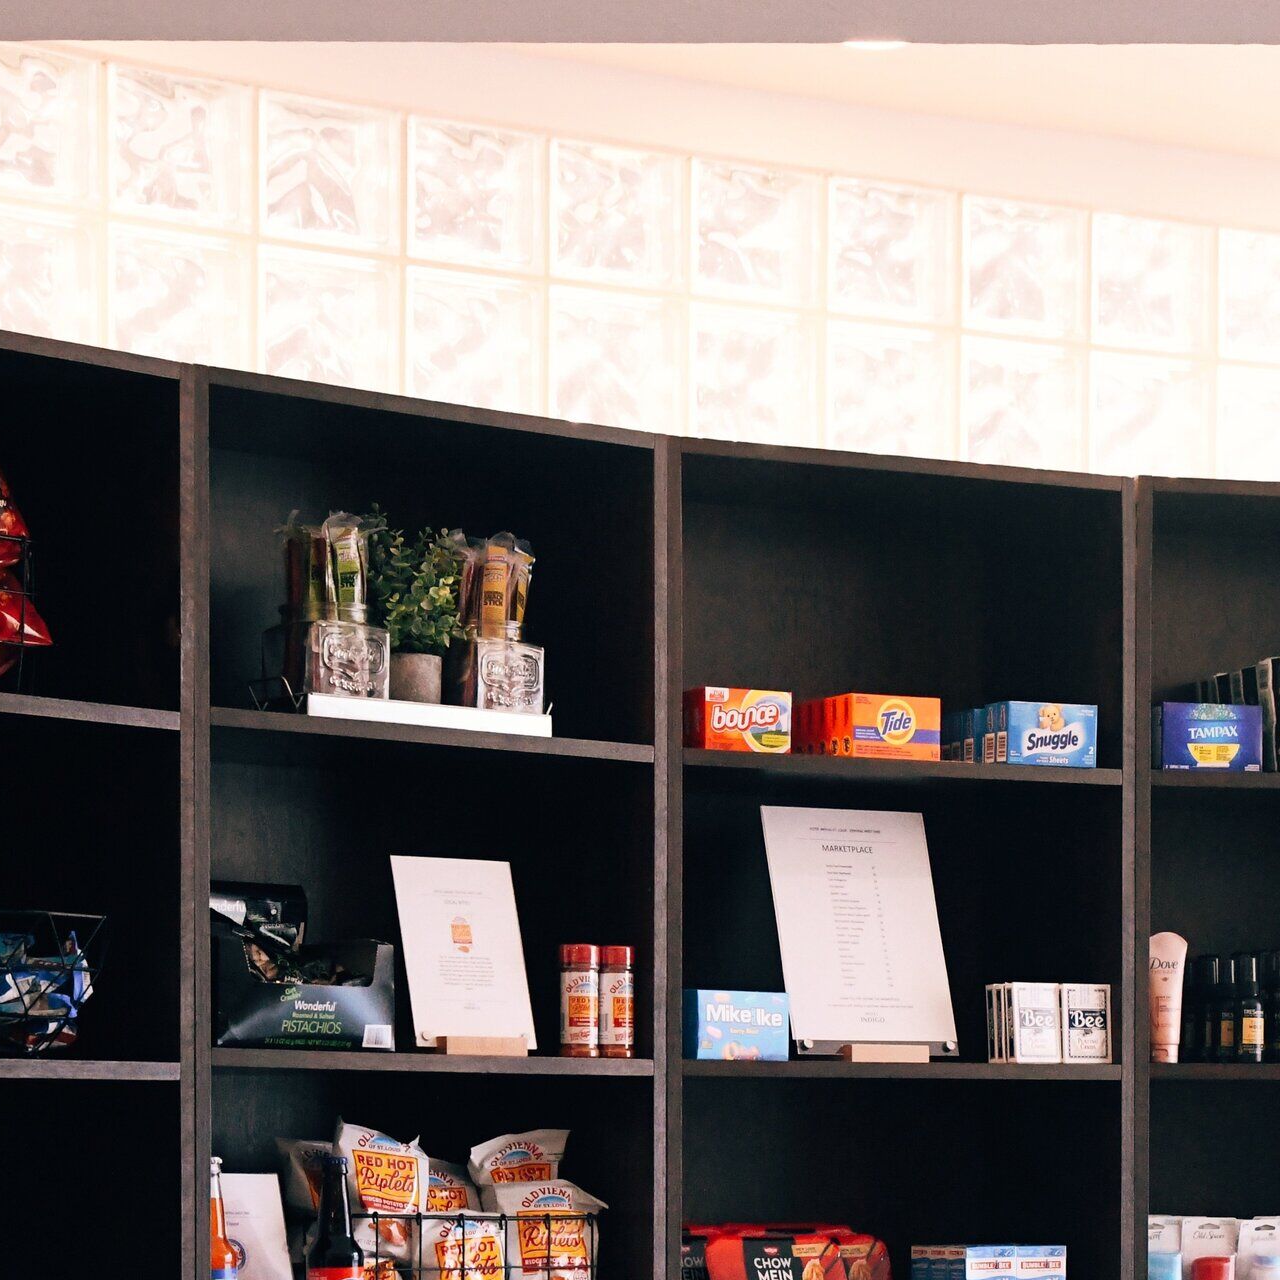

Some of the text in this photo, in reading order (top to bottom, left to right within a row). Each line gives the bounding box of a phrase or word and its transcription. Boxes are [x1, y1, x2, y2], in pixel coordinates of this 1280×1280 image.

[483, 599, 504, 607] STICK
[712, 703, 779, 731] bounce
[881, 711, 911, 735] Tide
[1188, 725, 1238, 739] TAMPAX
[1027, 729, 1079, 751] Snuggle
[1088, 746, 1095, 755] 2
[1049, 755, 1069, 765] Sheets
[822, 845, 873, 854] MARKETPLACE
[1150, 957, 1178, 970] Dove
[565, 979, 579, 994] OLD
[609, 979, 623, 994] OLD
[294, 1001, 336, 1011] Wonderful
[706, 1004, 783, 1026] Mike Ike
[860, 1016, 885, 1024] INDIGO
[1021, 1009, 1054, 1027] Bee
[1070, 1010, 1104, 1028] Bee
[281, 1019, 342, 1034] PISTACHIOS
[491, 1142, 544, 1167] OLD VIENNA
[357, 1154, 415, 1172] RED HOT
[360, 1166, 415, 1193] Riplets
[522, 1190, 540, 1208] OLD
[439, 1219, 455, 1238] OLD
[523, 1223, 581, 1248] Riplets
[753, 1258, 792, 1269] CHOW
[972, 1261, 995, 1269] BUMBLE
[1022, 1261, 1045, 1269] BUMBLE
